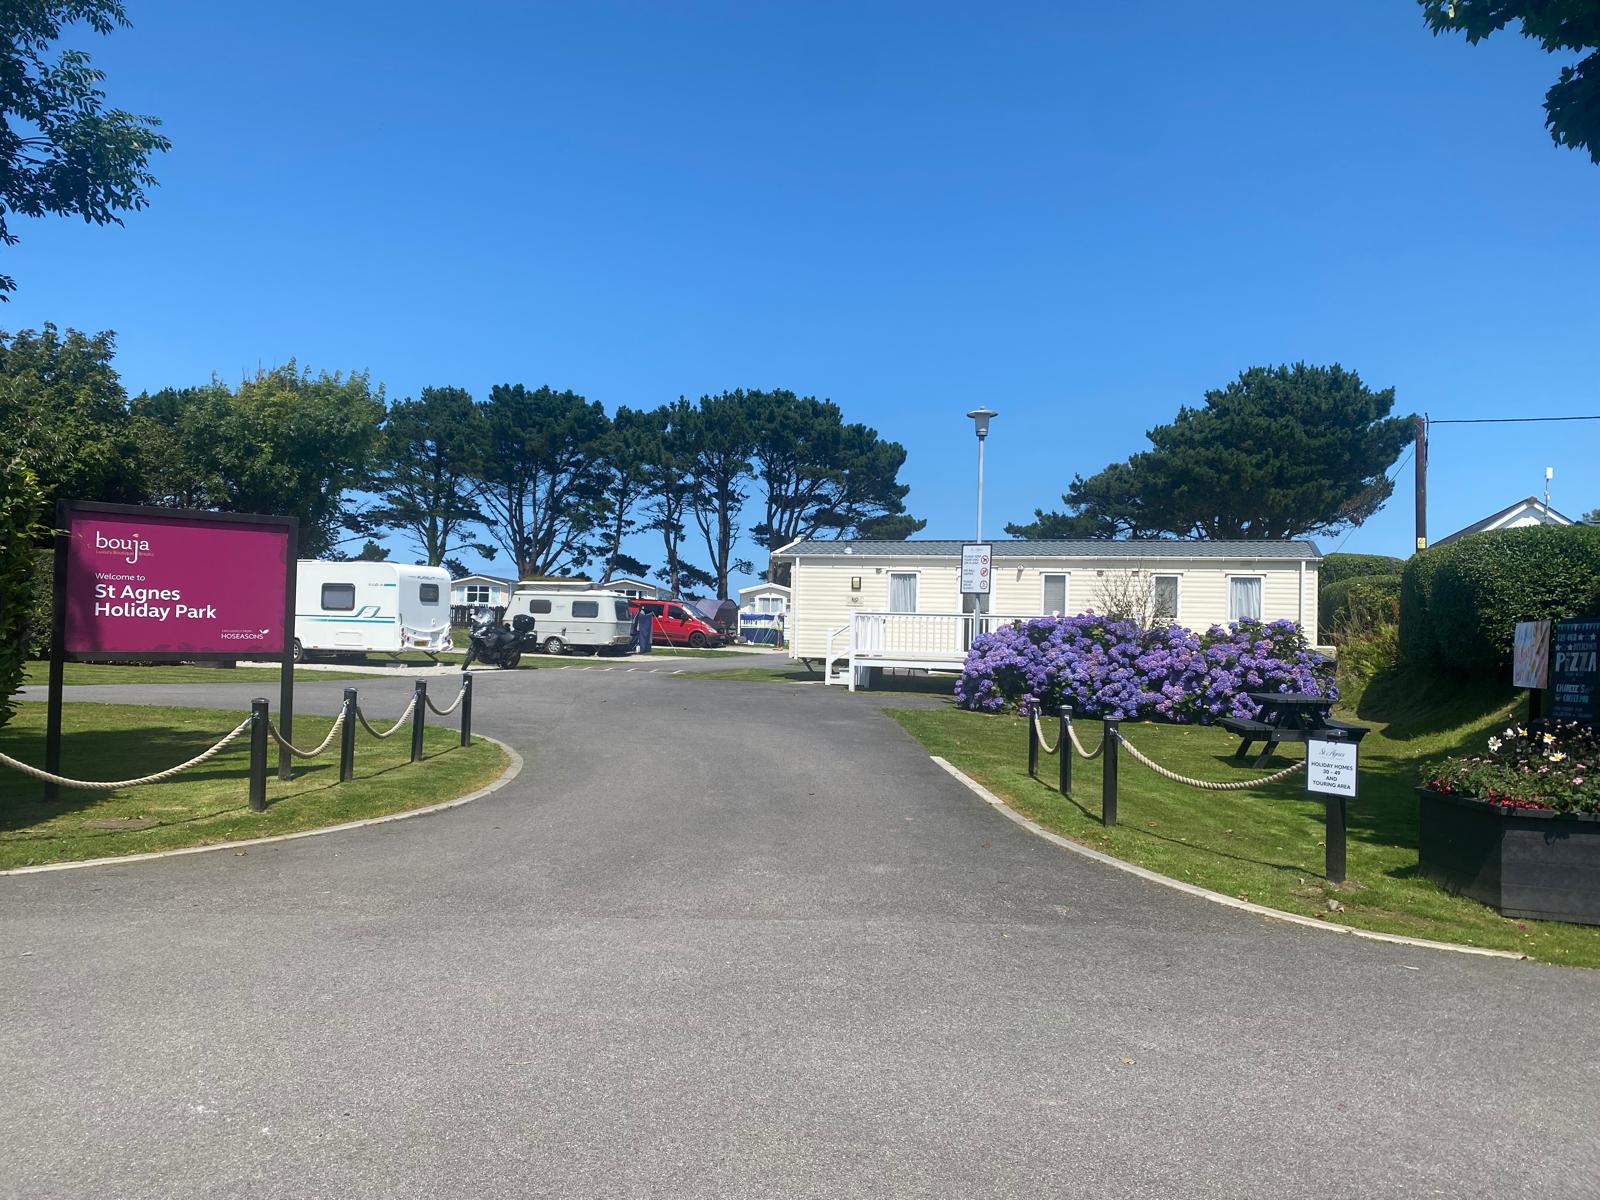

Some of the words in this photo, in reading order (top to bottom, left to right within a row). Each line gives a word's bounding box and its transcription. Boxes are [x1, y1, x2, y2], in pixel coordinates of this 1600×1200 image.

[96, 530, 150, 564] bouja
[95, 584, 116, 598] St
[120, 584, 180, 604] Agnes
[94, 602, 170, 622] Holiday
[176, 604, 216, 618] Park
